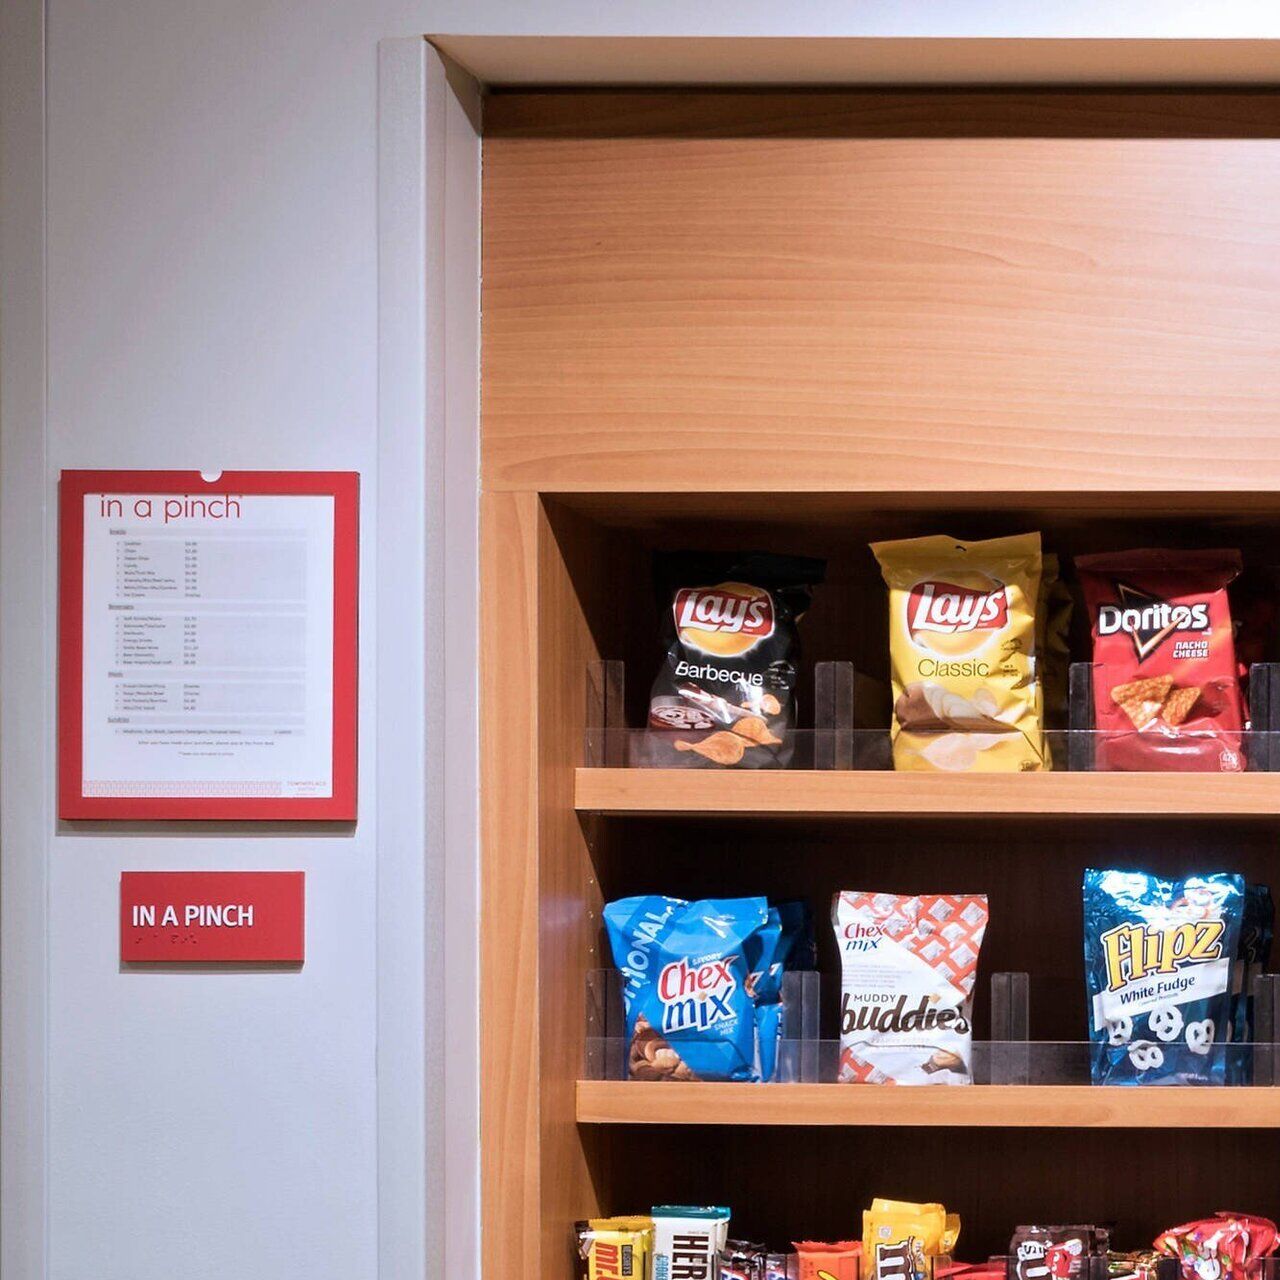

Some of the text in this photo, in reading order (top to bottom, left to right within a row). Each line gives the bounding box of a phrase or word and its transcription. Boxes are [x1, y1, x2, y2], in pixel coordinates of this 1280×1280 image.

[101, 494, 240, 524] in a pinch
[679, 591, 768, 633] Lay's
[1099, 603, 1209, 634] Doritos
[1172, 648, 1209, 658] CHEESE
[1175, 641, 1209, 650] NACHO
[675, 660, 764, 687] Barbecue
[917, 658, 990, 678] Classic
[131, 904, 254, 927] IN A PINCH
[843, 922, 885, 939] Chex
[844, 937, 883, 952] mix
[1102, 918, 1223, 993] Flipz
[660, 954, 740, 1000] Chex
[1119, 983, 1155, 1006] White
[1156, 974, 1197, 999] Fudge
[665, 985, 734, 1031] mix
[853, 993, 897, 1004] MUDDY
[841, 993, 970, 1036] buddies
